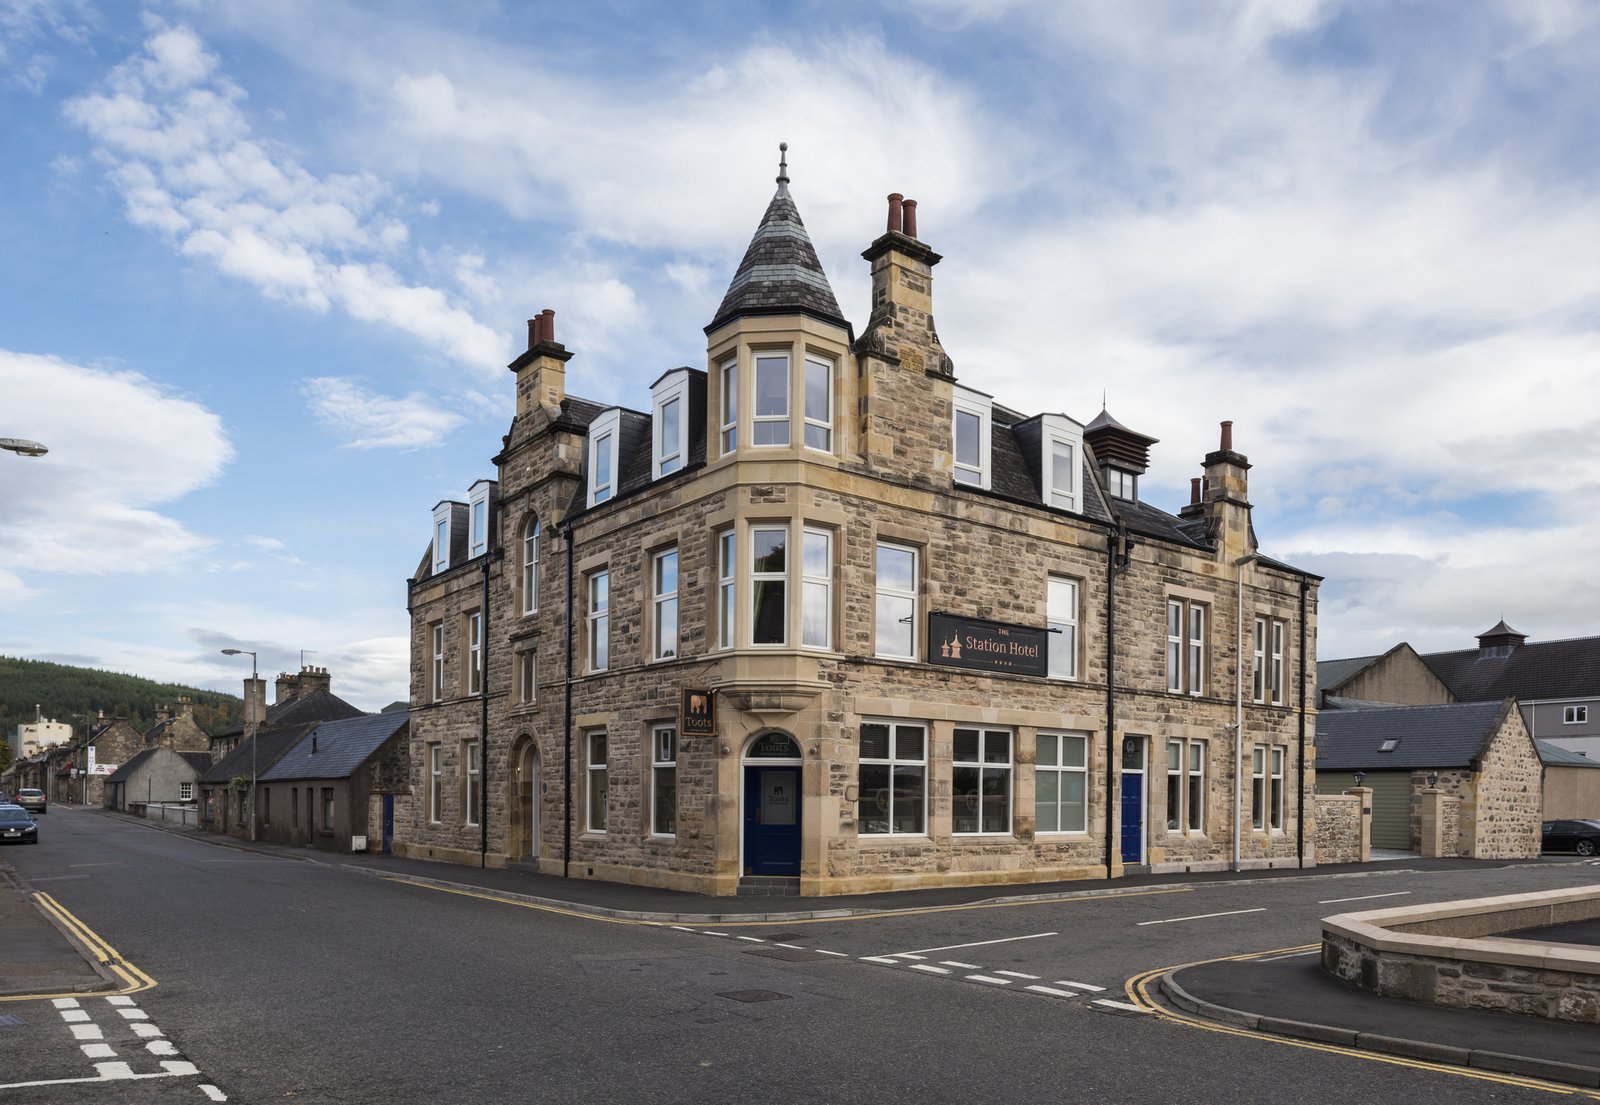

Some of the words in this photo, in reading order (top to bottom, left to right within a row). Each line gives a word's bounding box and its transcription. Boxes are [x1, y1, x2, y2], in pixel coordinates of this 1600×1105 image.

[998, 628, 1009, 636] THE
[966, 636, 1007, 654] Station
[1009, 641, 1038, 657] Hotel
[685, 716, 712, 727] Toots
[759, 742, 789, 752] Toots
